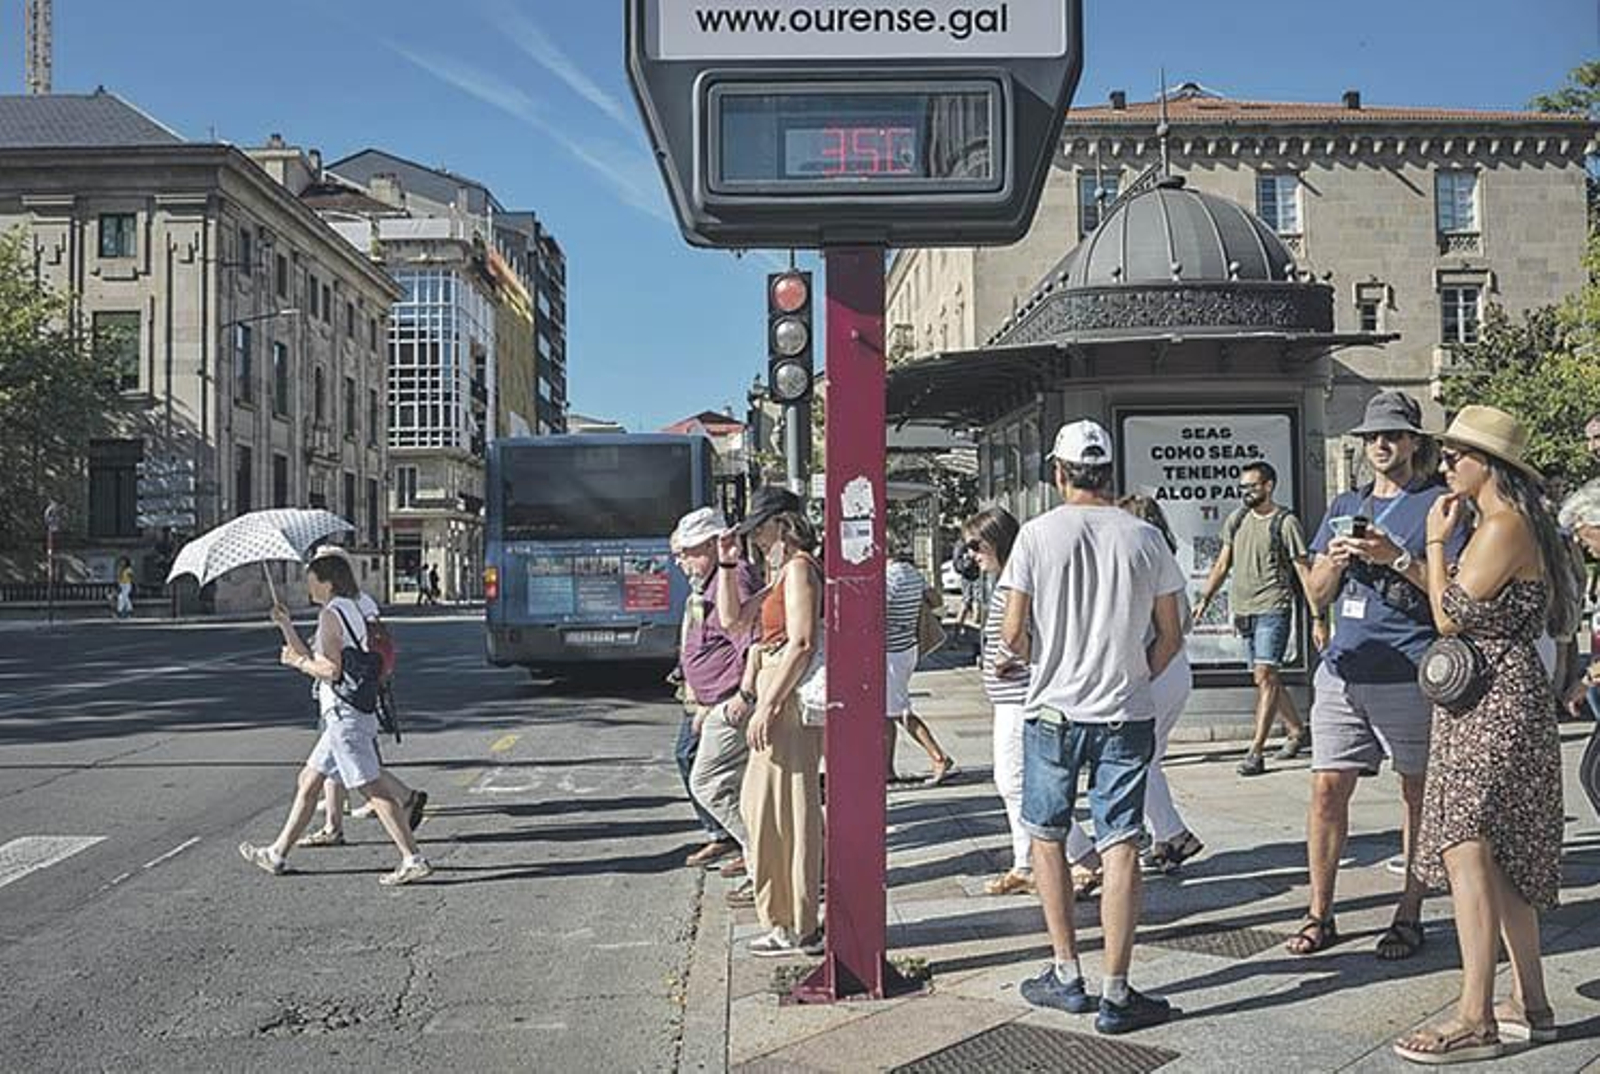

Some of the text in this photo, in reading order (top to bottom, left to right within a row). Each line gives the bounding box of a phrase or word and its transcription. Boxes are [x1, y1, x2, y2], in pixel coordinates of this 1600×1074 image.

[695, 3, 1008, 40] www.ourense.gal
[1181, 427, 1232, 439] SEAS
[1151, 445, 1205, 460] COMO
[1163, 465, 1241, 479] TENEMO
[1156, 486, 1207, 500] ALGO
[1200, 506, 1219, 520] TI
